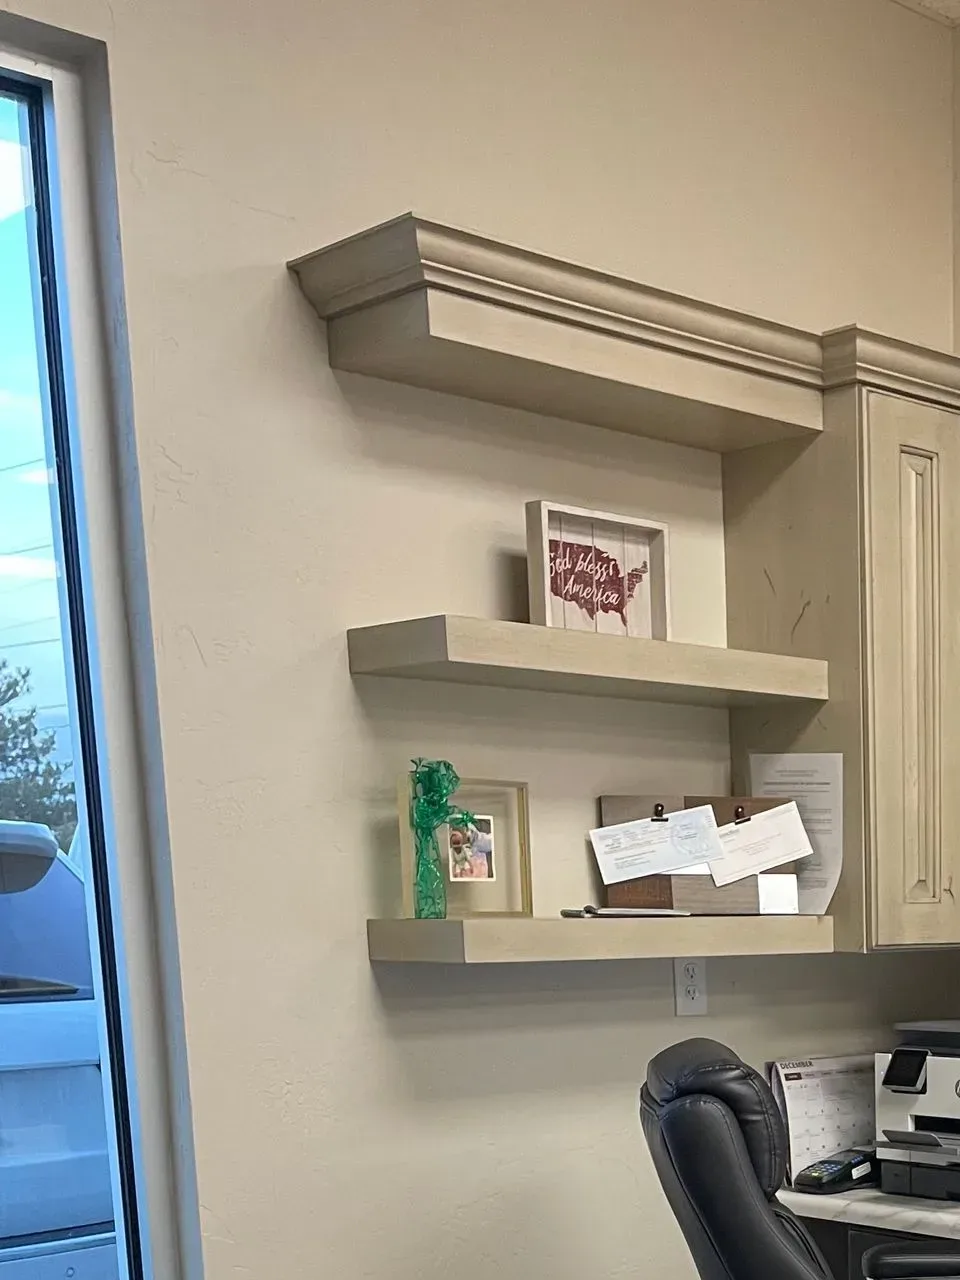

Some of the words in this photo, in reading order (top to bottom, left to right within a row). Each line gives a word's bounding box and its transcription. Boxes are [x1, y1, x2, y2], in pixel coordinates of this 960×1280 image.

[575, 552, 608, 582] bless
[564, 575, 621, 605] America
[780, 1060, 814, 1070] DECEMBER
